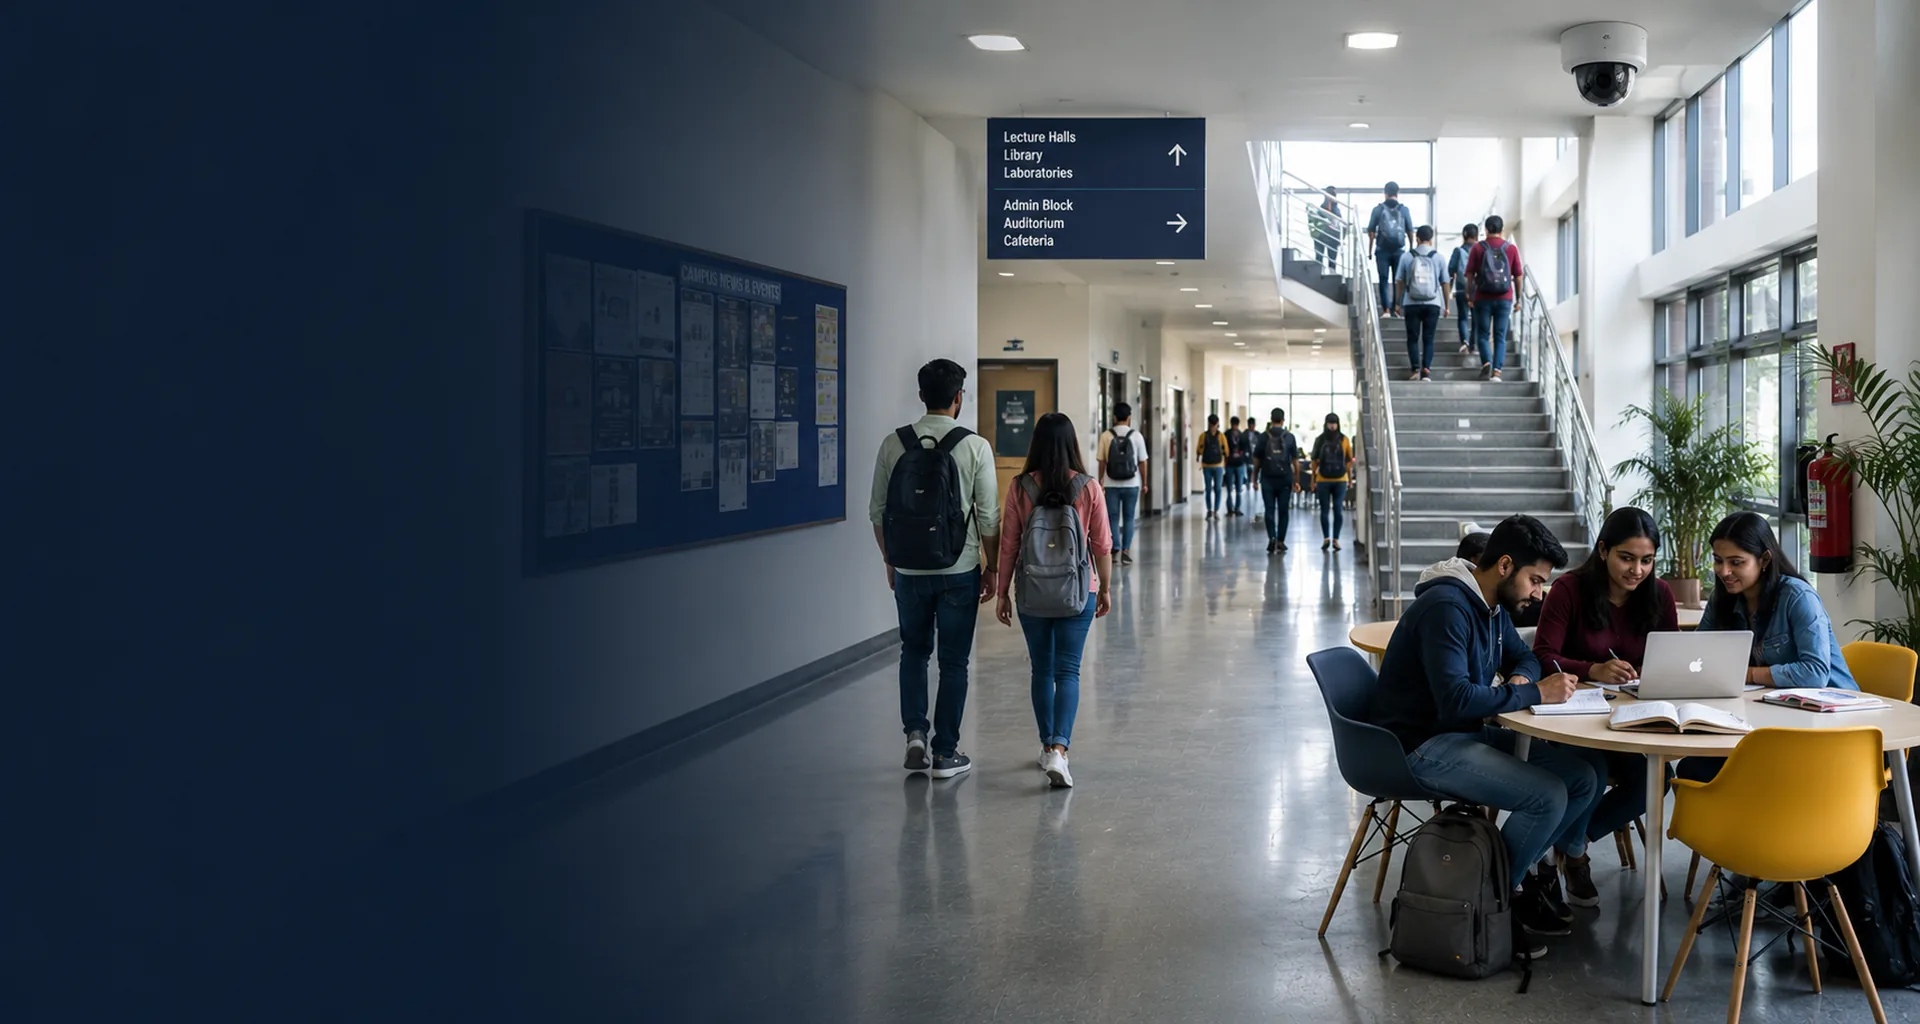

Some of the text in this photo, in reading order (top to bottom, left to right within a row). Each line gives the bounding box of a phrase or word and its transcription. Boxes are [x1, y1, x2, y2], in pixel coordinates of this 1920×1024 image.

[1004, 130, 1077, 143] Lecture Halls
[1004, 148, 1043, 164] Library
[1004, 166, 1074, 179] Laboratories
[1003, 198, 1074, 211] Admin Block
[1003, 216, 1065, 229] Auditorium
[1003, 234, 1054, 247] Cafeteria
[681, 264, 718, 286] CAMPUS
[719, 272, 743, 292] NEWS
[752, 280, 780, 300] EVENTS
